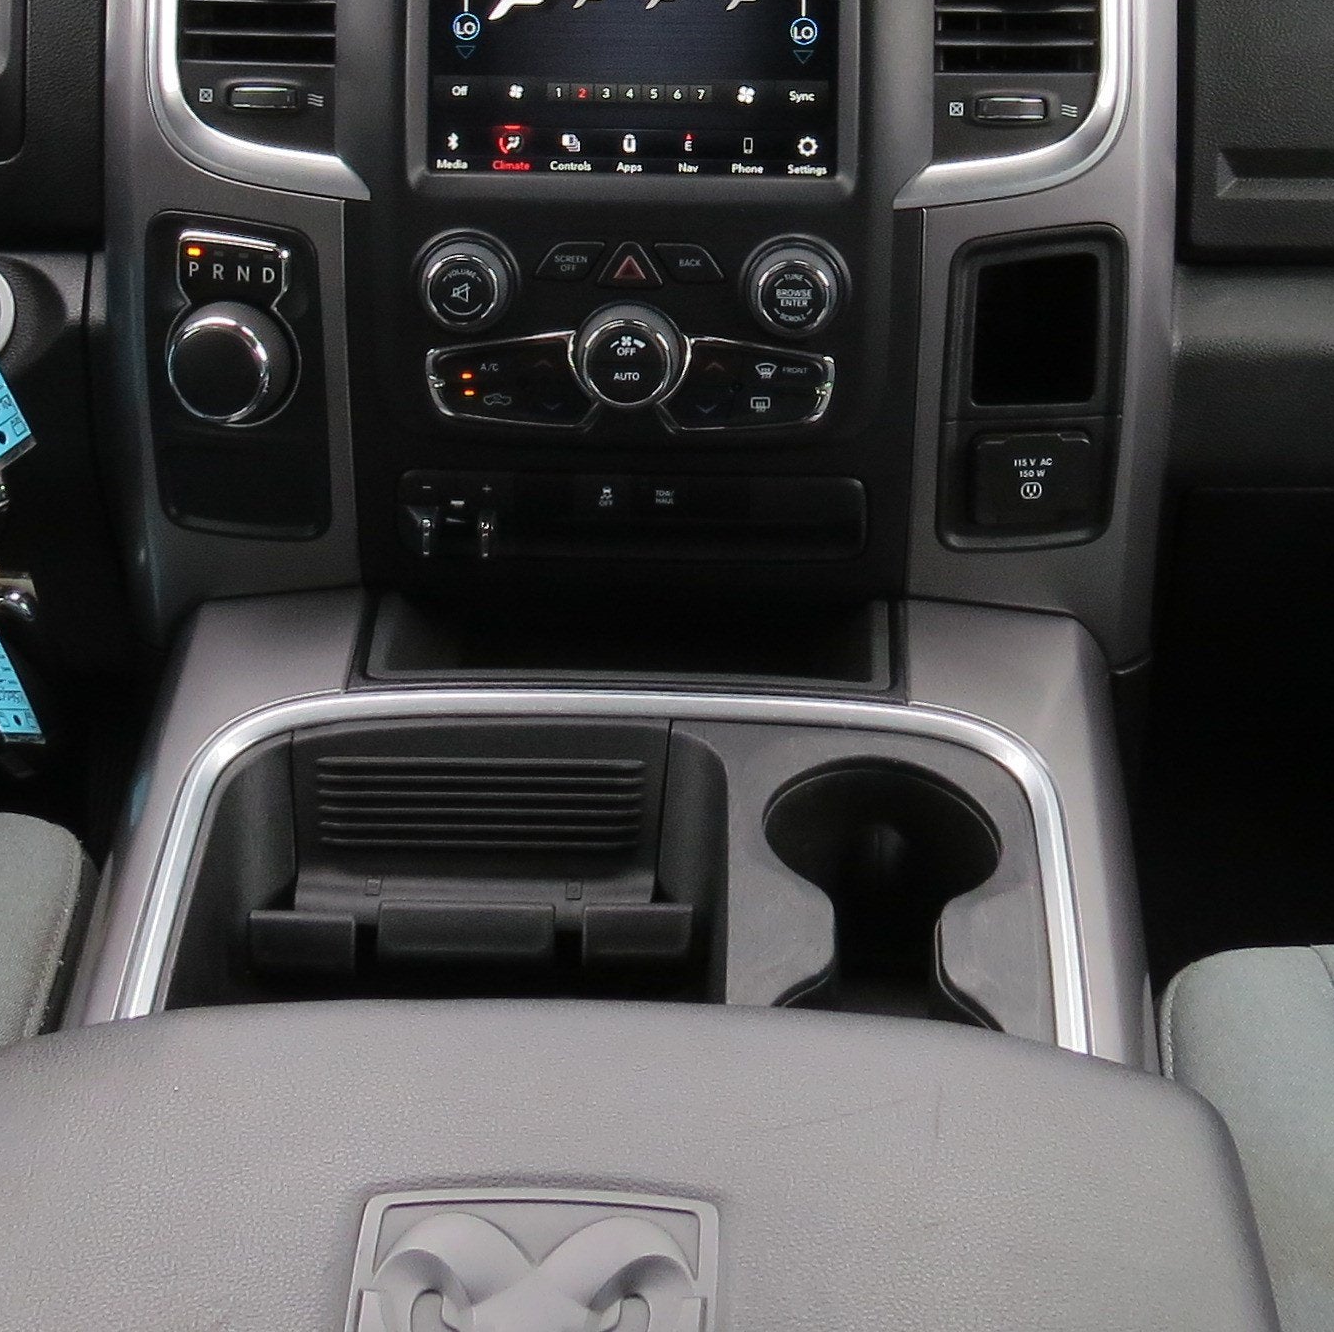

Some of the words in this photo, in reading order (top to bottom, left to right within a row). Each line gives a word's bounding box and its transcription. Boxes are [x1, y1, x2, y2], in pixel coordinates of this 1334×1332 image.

[455, 20, 476, 35] LO
[793, 25, 814, 40] LO
[451, 84, 468, 97] Off
[555, 87, 562, 98] 1
[578, 87, 587, 99] 2
[602, 87, 610, 99] 3
[626, 88, 634, 99] 4
[650, 88, 658, 100] 5
[673, 89, 682, 100] 6
[697, 89, 705, 100] 7
[788, 90, 815, 103] Sync
[436, 159, 468, 170] Media
[492, 159, 531, 171] Climate
[550, 160, 592, 172] Controls
[616, 161, 643, 174] Apps
[678, 162, 699, 173] Nav
[731, 162, 764, 174] Phone
[787, 163, 828, 177] Settings
[554, 255, 588, 264] SCREEN
[678, 259, 702, 268] BACK
[188, 261, 200, 278] P
[212, 264, 224, 280] R
[236, 265, 250, 282] N
[560, 264, 577, 272] OFF
[262, 267, 275, 284] D
[447, 269, 477, 279] VOLUME
[784, 273, 804, 281] TUNE
[776, 288, 813, 297] BROWSE
[780, 299, 809, 307] ENTER
[616, 347, 637, 357] OFF
[480, 363, 499, 372] A/C
[782, 366, 808, 374] FRONT
[613, 372, 641, 382] AUTO
[1013, 458, 1028, 467] 115
[1029, 458, 1036, 467] V
[1040, 458, 1053, 466] AC
[1019, 469, 1035, 478] 150
[1036, 469, 1046, 478] W
